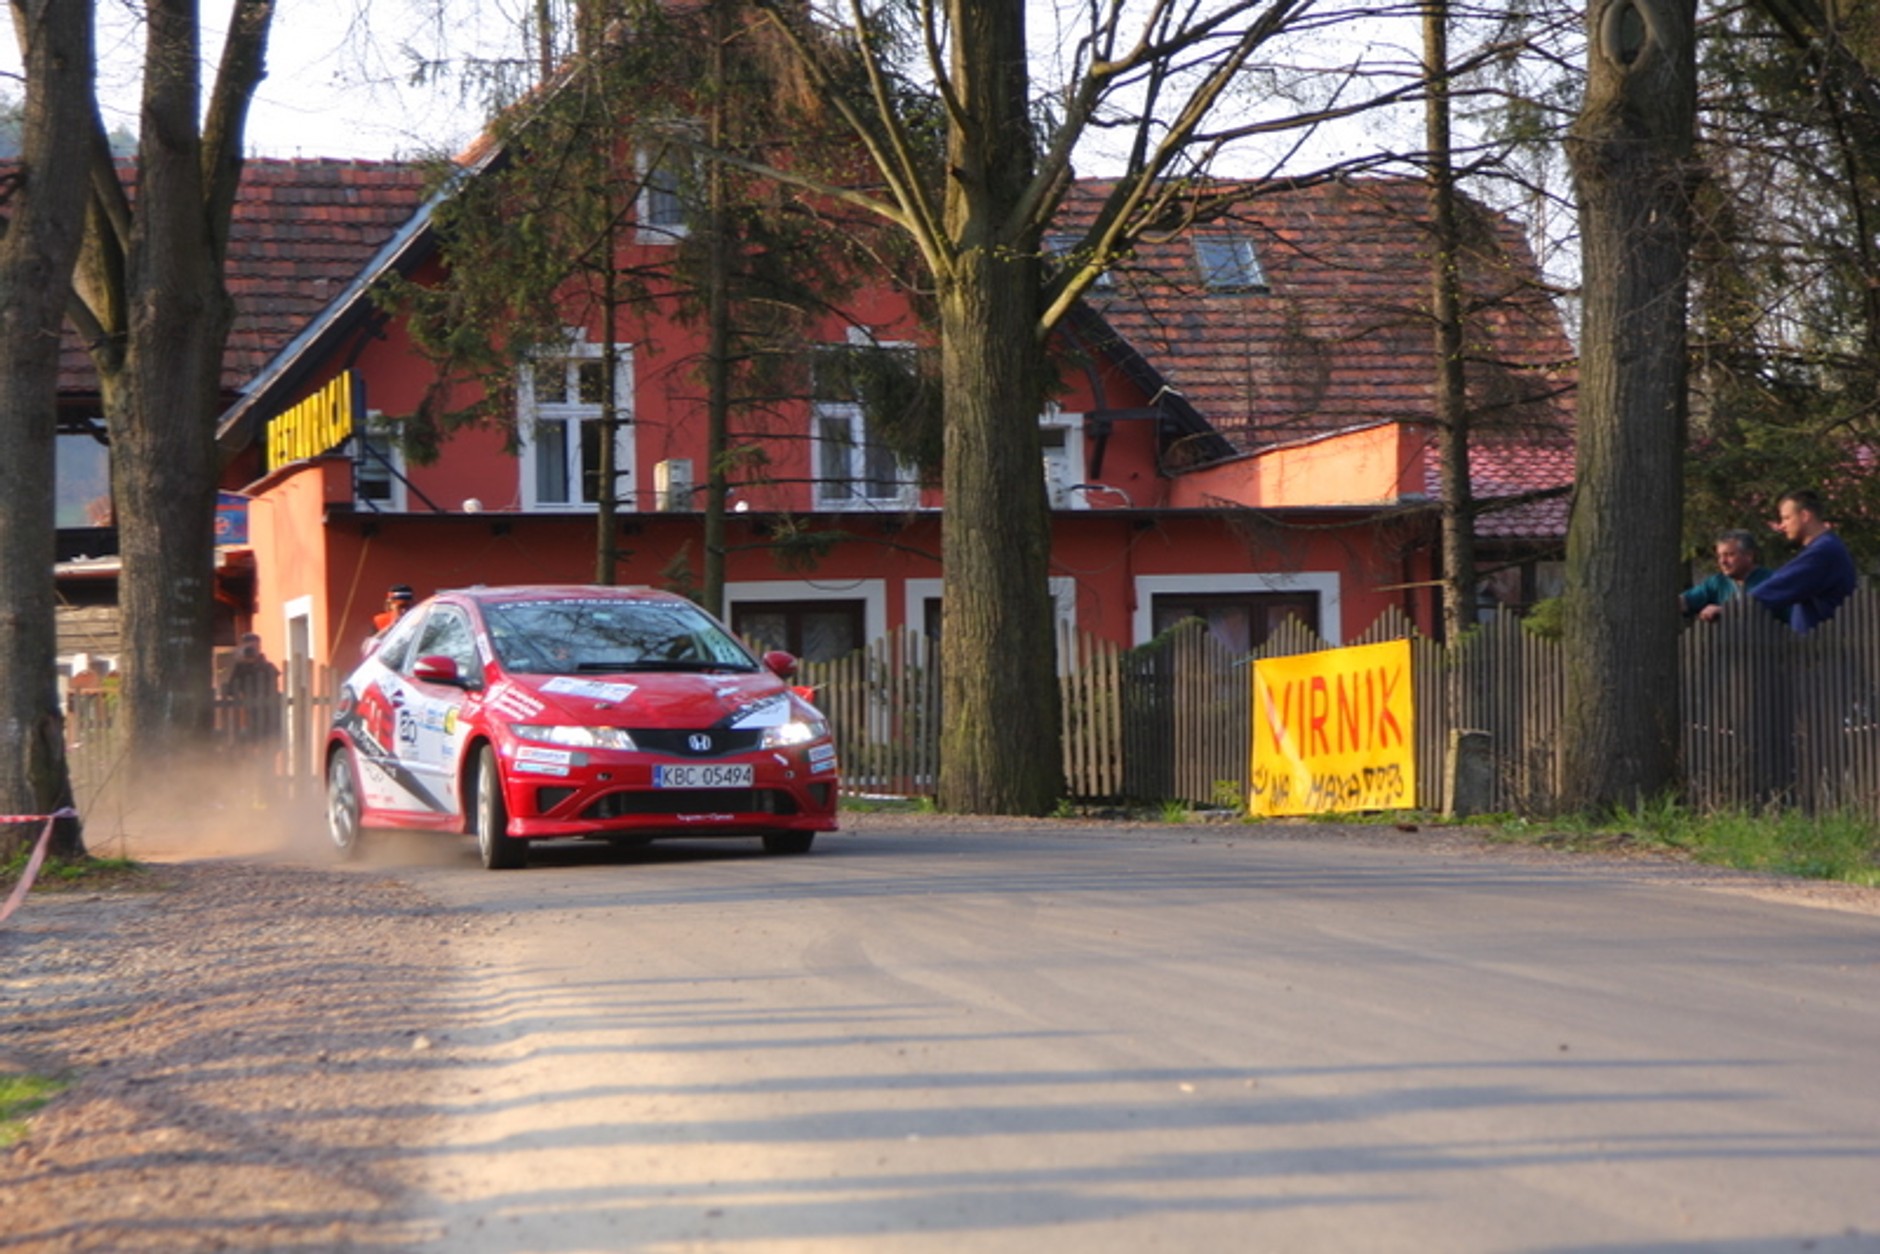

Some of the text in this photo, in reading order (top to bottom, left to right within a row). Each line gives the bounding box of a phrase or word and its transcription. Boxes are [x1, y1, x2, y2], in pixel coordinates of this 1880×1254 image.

[1266, 664, 1403, 760] VIRNIK
[664, 766, 752, 786] KBC 05494
